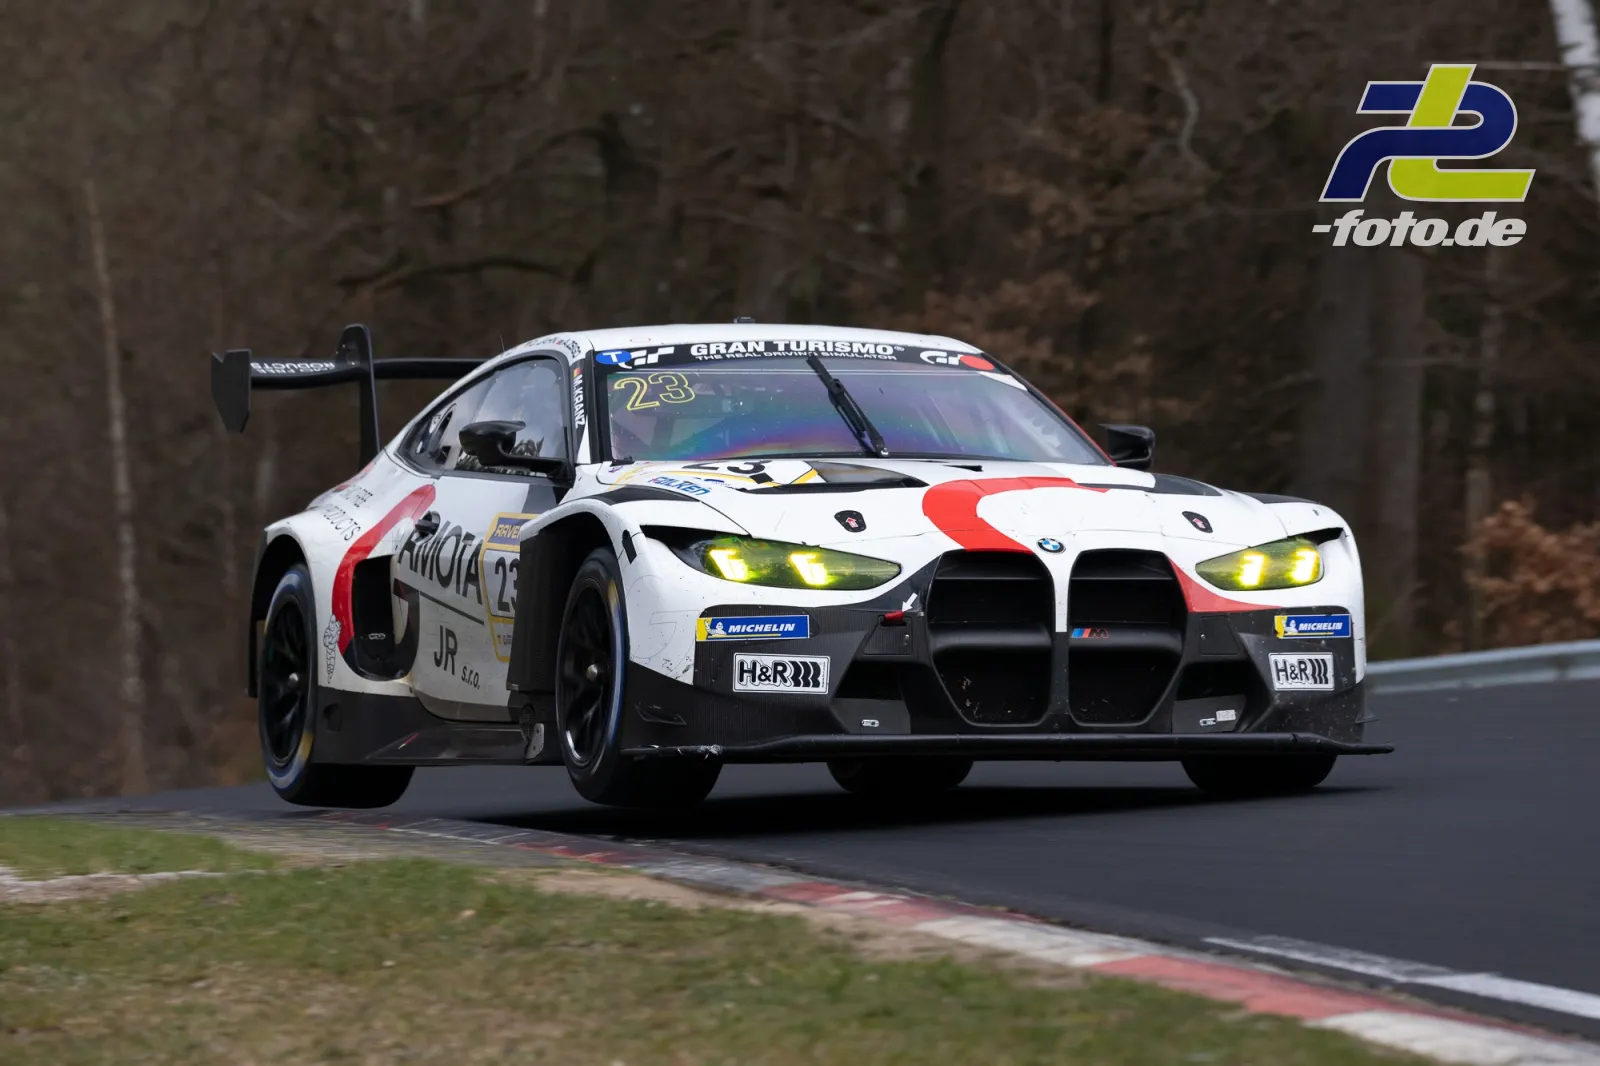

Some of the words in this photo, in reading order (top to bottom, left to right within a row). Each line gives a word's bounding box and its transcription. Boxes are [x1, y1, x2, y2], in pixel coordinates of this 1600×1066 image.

[690, 342, 765, 357] GRAN
[821, 351, 897, 361] SIMULATOR
[614, 371, 696, 411] 23
[728, 622, 796, 633] MICHELIN
[1298, 621, 1343, 632] MICHELIN
[433, 624, 458, 676] JR
[461, 665, 481, 691] s.r.o.
